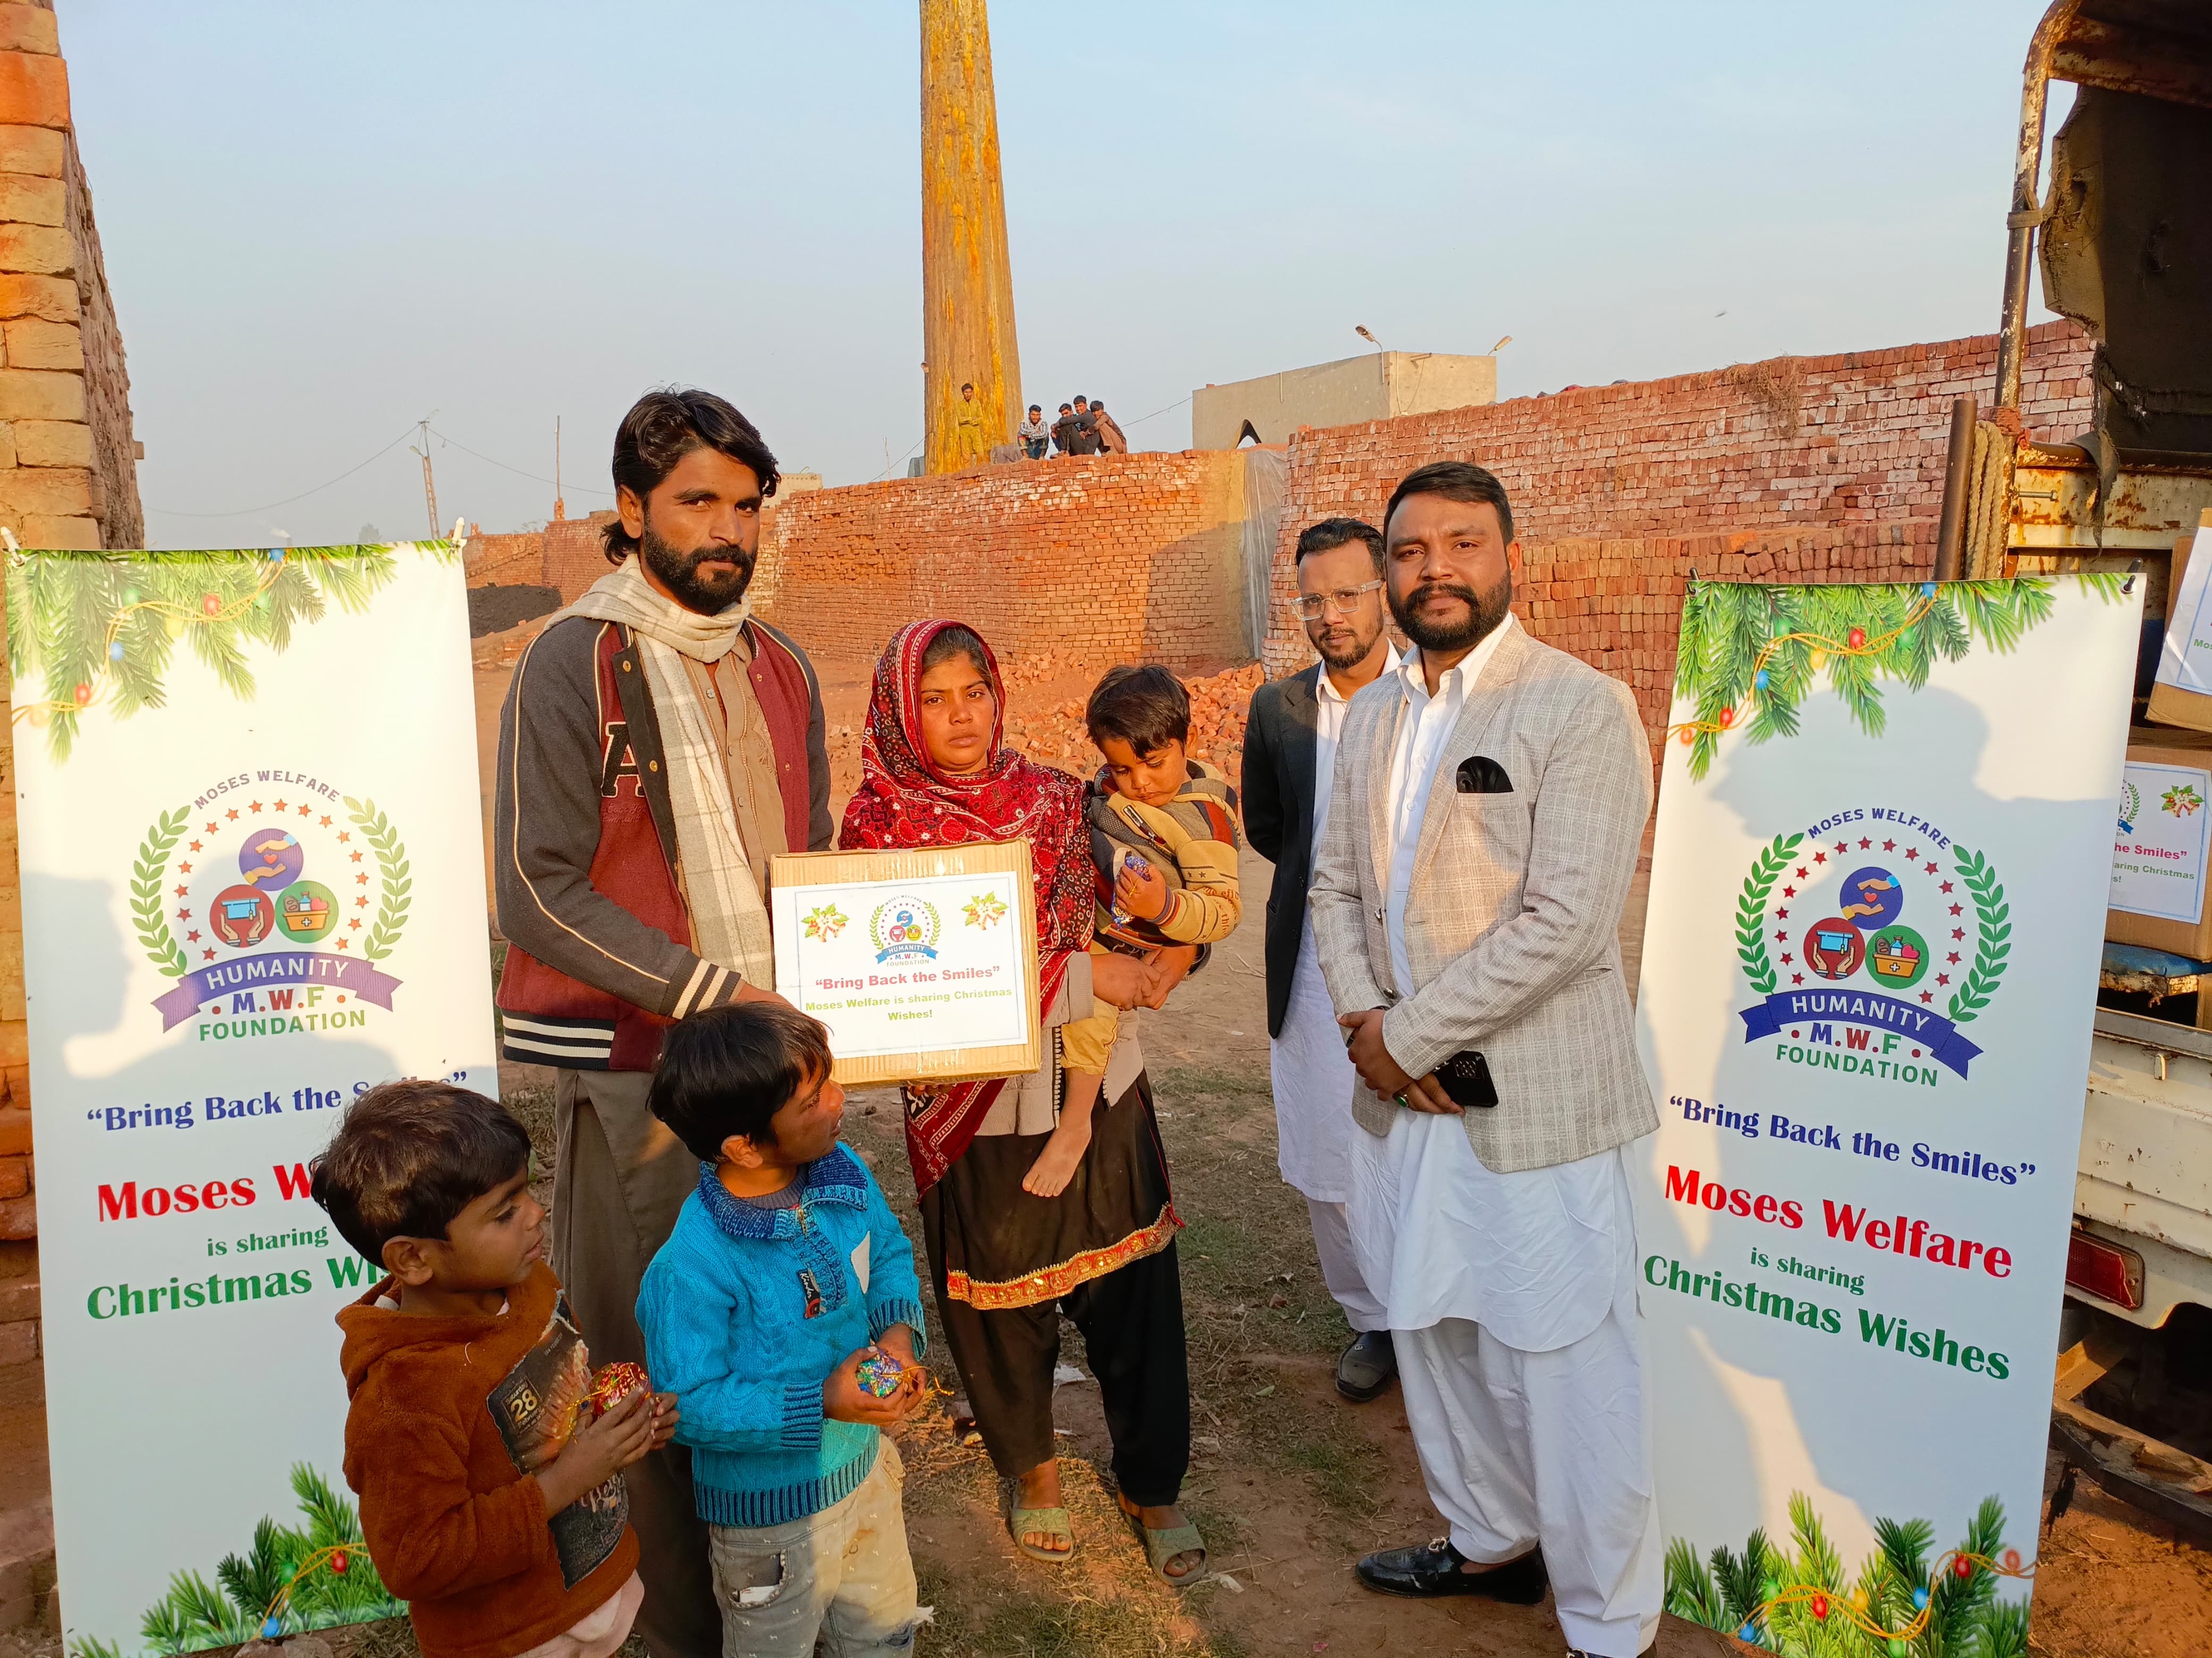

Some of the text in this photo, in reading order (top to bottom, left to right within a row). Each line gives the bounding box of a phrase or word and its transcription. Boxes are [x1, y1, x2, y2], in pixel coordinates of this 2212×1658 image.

[194, 770, 340, 810] MOSES WELFARE
[1808, 807, 1951, 851] MOSES WELFARE
[2115, 843, 2187, 860] he Smiles”
[2114, 862, 2195, 880] aring Christmas
[888, 945, 925, 954] HUMANITY
[206, 958, 349, 990] HUMANITY
[816, 966, 1000, 990] “Bring Back the Smiles”
[806, 1002, 842, 1011] Moses
[847, 998, 890, 1008] Welfare
[908, 993, 950, 1005] sharing
[954, 988, 1012, 999] Christmas
[888, 1010, 933, 1021] Wishes!
[1792, 996, 1930, 1031] HUMANITY
[199, 1009, 365, 1041] FOUNDATION
[1776, 1044, 1938, 1087] FOUNDATION
[87, 1087, 342, 1131] “Bring Back the
[1670, 1096, 2035, 1185] “Bring Back the Smiles”
[98, 1177, 256, 1222] Moses
[1665, 1165, 2012, 1278] Moses Welfare
[207, 1226, 328, 1257] is sharing
[1750, 1247, 1865, 1296] is sharing
[87, 1268, 313, 1320] Christmas
[1644, 1255, 2010, 1380] Christmas Wishes
[506, 1381, 528, 1404] Saturday
[510, 1389, 538, 1422] 28
